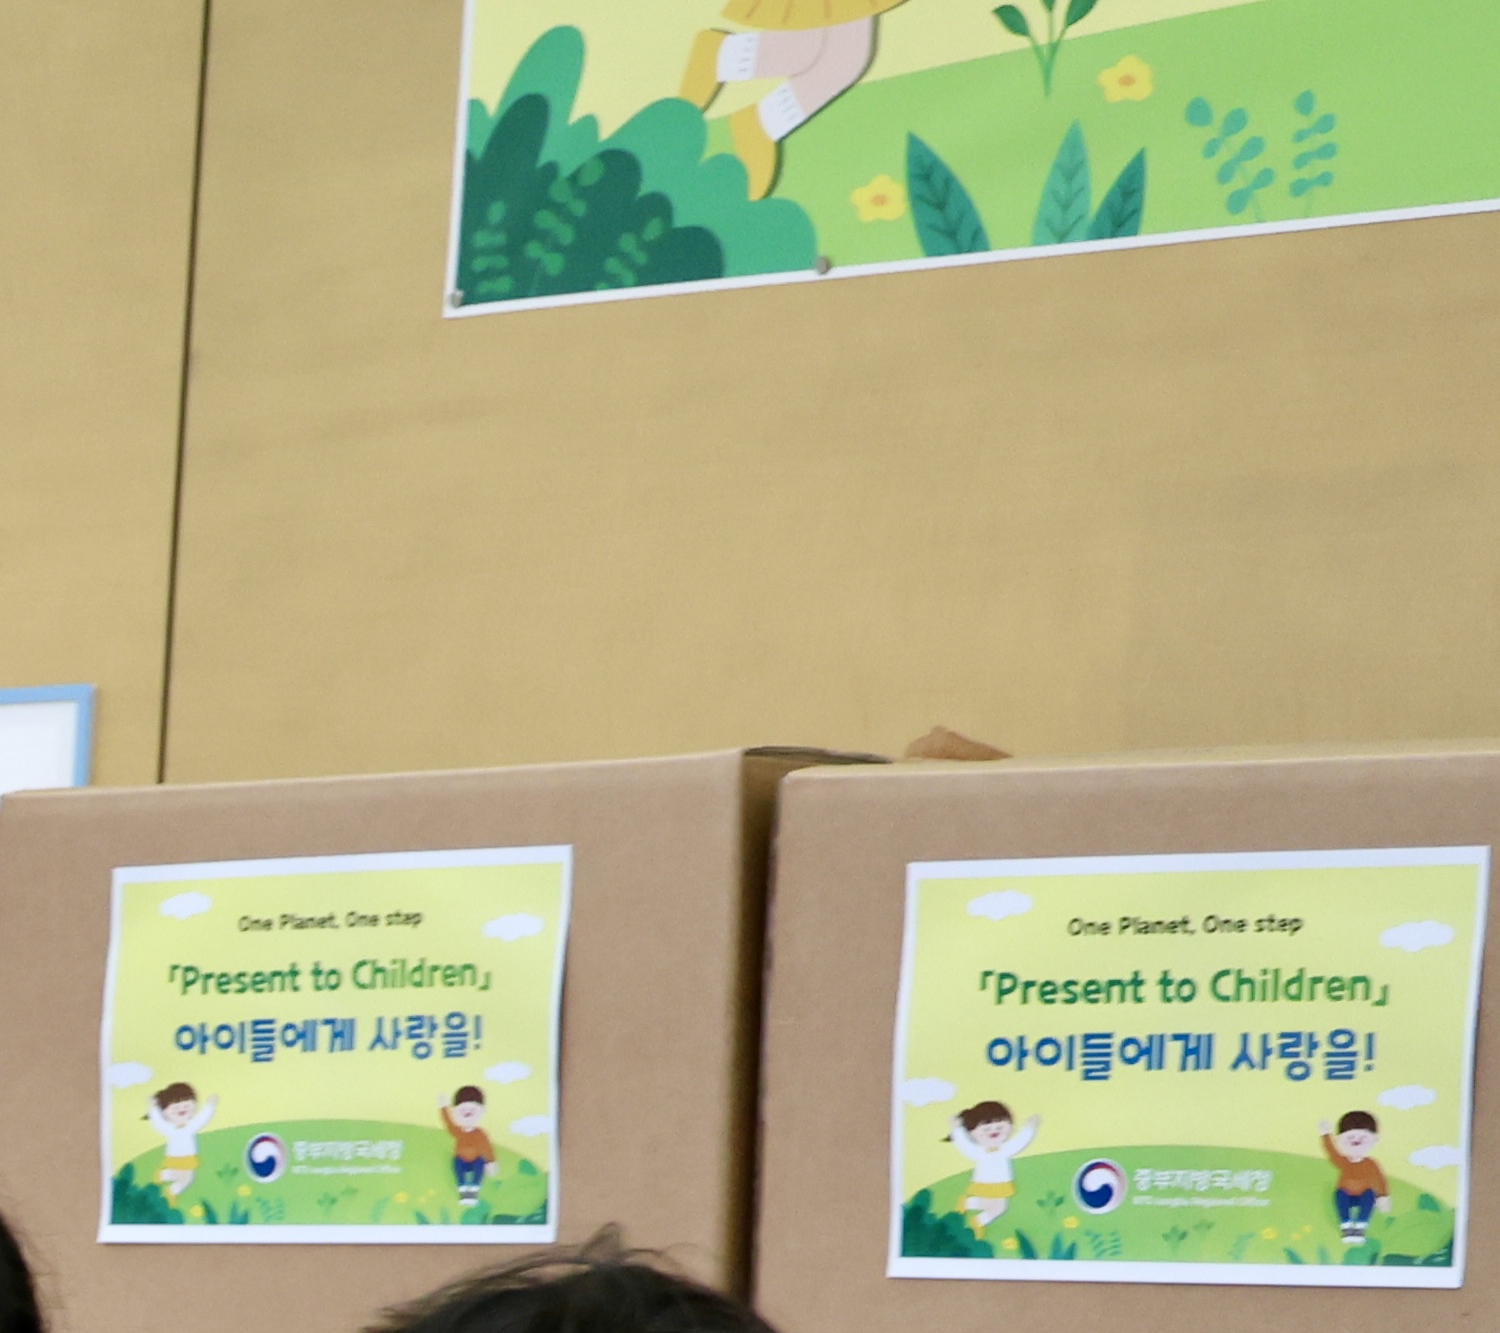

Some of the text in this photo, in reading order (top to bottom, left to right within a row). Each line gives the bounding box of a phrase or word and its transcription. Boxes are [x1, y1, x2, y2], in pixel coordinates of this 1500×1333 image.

[238, 909, 422, 932] One Planet, One step
[1068, 913, 1304, 937] One Planet, One step
[312, 962, 340, 991] to
[1159, 973, 1197, 1003] to
[175, 1011, 483, 1063] 아이들에게 사랑을!
[986, 1028, 1376, 1081] 아이들에게 사랑을!
